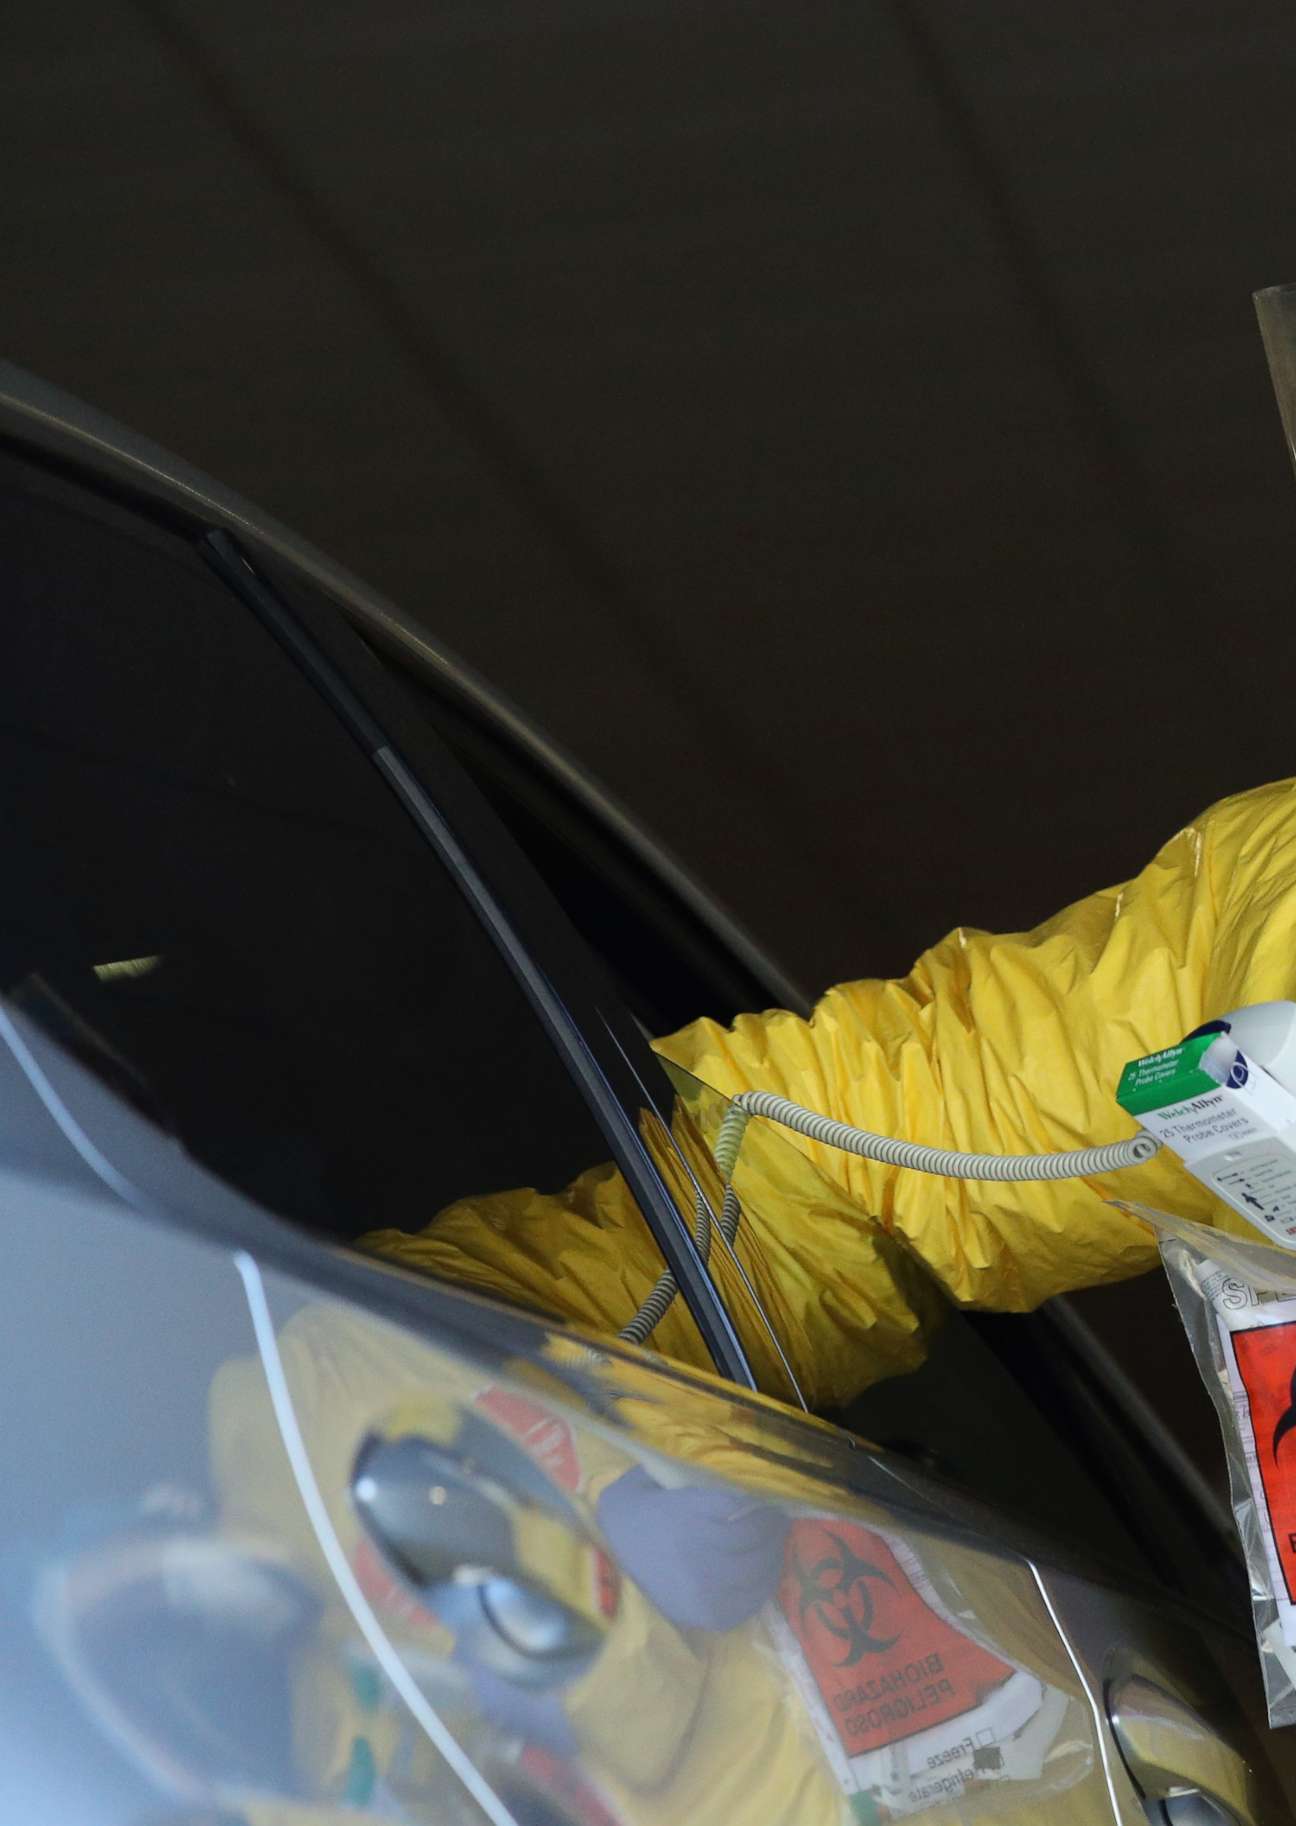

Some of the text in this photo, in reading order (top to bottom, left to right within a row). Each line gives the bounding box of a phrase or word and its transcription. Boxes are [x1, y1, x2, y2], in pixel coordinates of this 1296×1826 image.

[1160, 1128, 1174, 1139] 25
[1173, 1108, 1236, 1134] Thermometer
[1183, 1127, 1214, 1143] Probe
[1215, 1118, 1249, 1134] Covers
